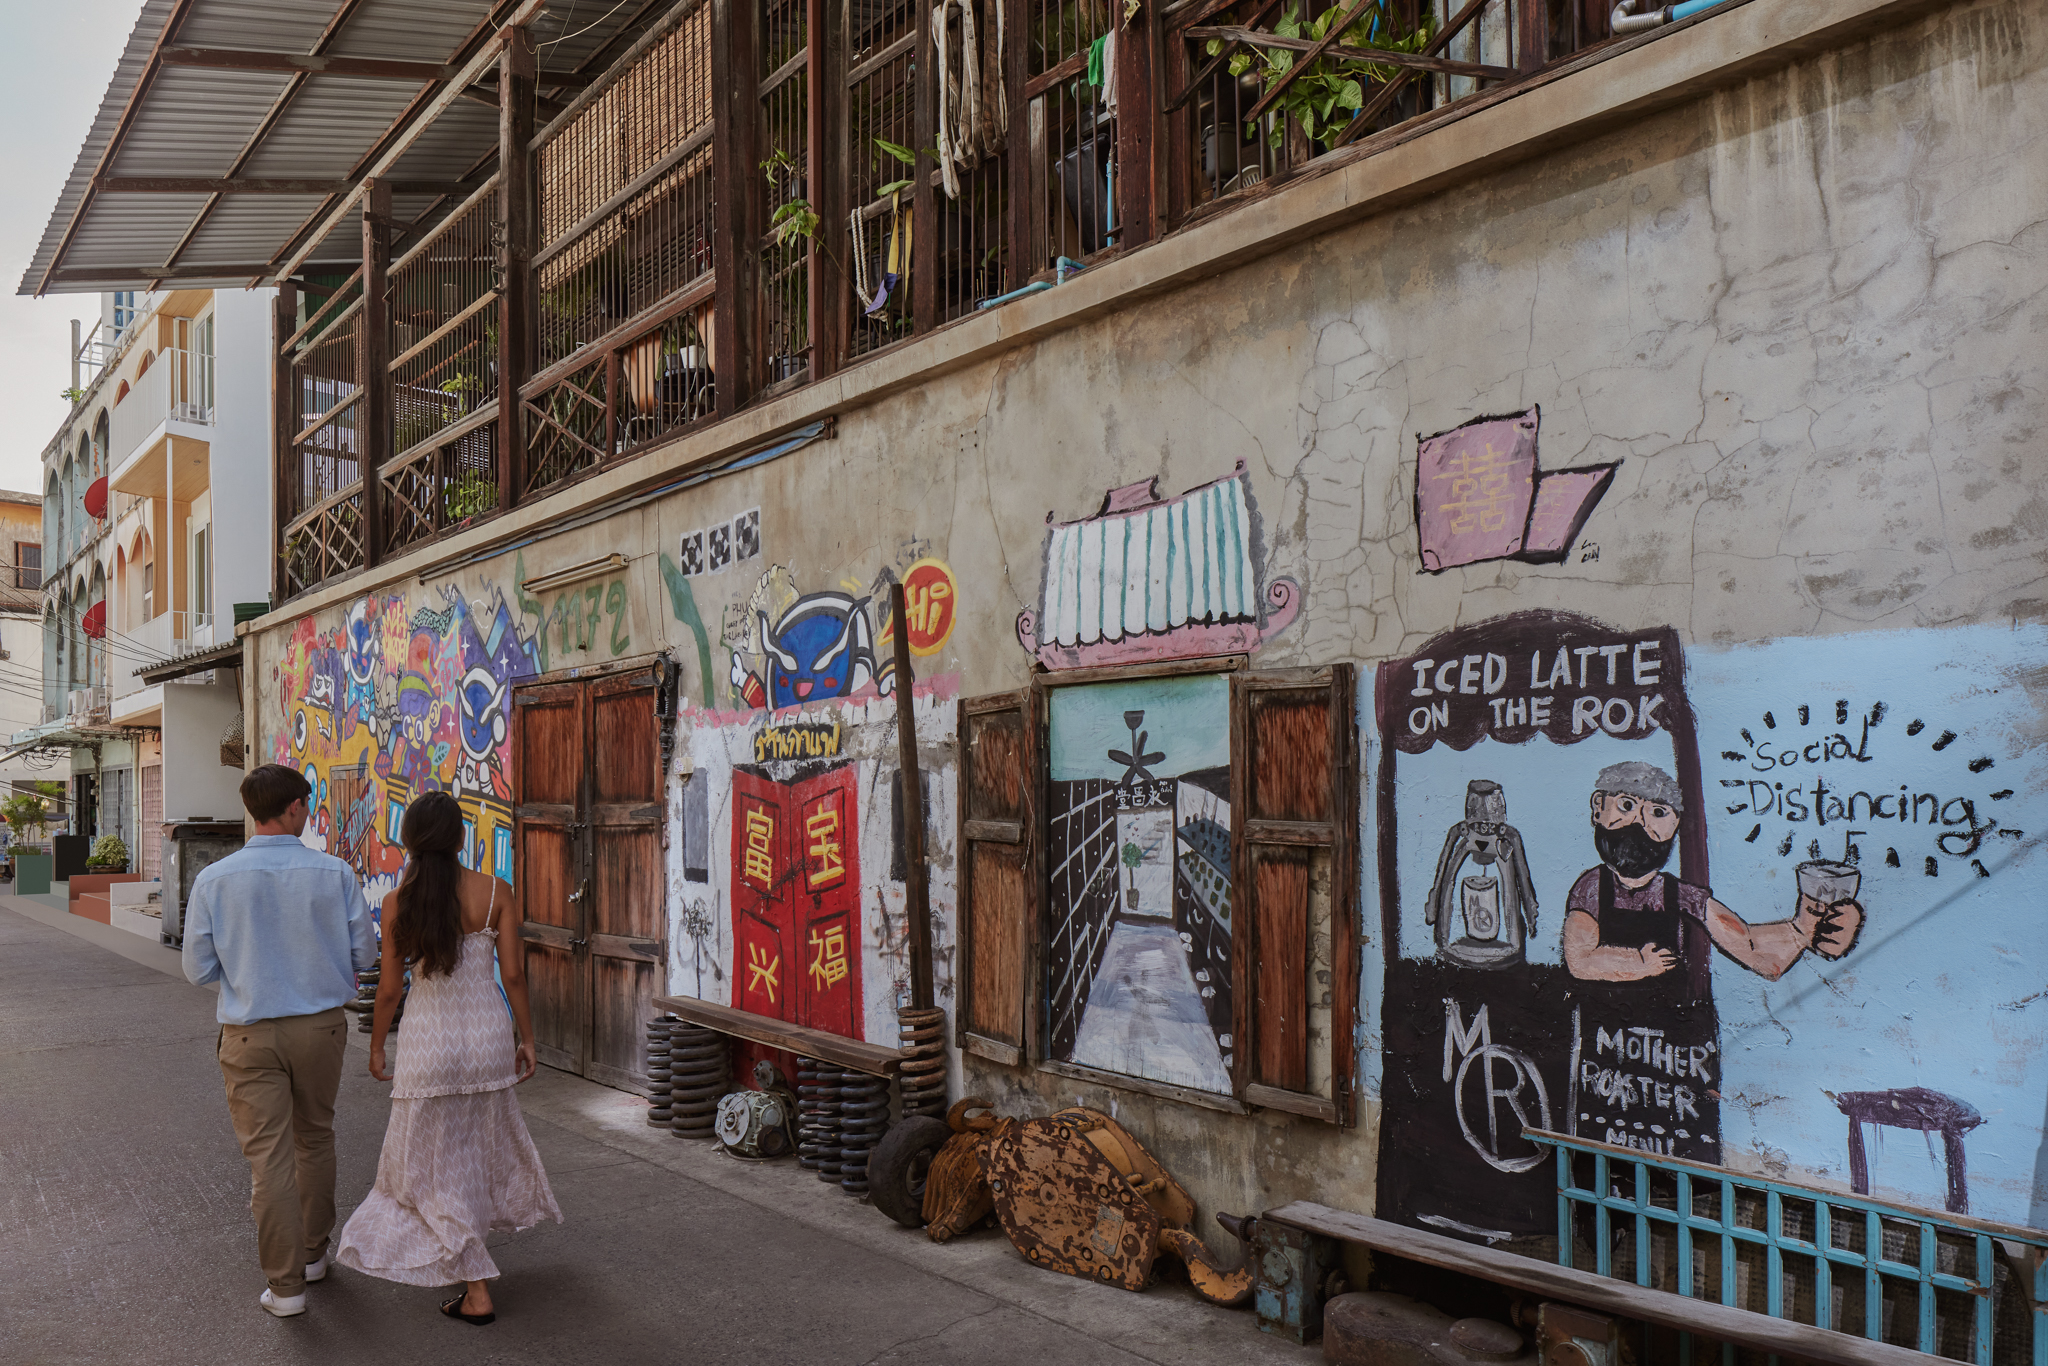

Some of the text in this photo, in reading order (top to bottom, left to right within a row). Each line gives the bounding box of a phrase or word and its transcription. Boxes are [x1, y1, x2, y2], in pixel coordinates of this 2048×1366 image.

[905, 582, 951, 635] Hi
[1411, 641, 1662, 697] ICED LATTE
[1409, 693, 1664, 735] ON THE ROK
[1751, 714, 1873, 772] Social
[1748, 778, 1997, 860] Distancing
[1581, 1059, 1700, 1122] ROASTER
